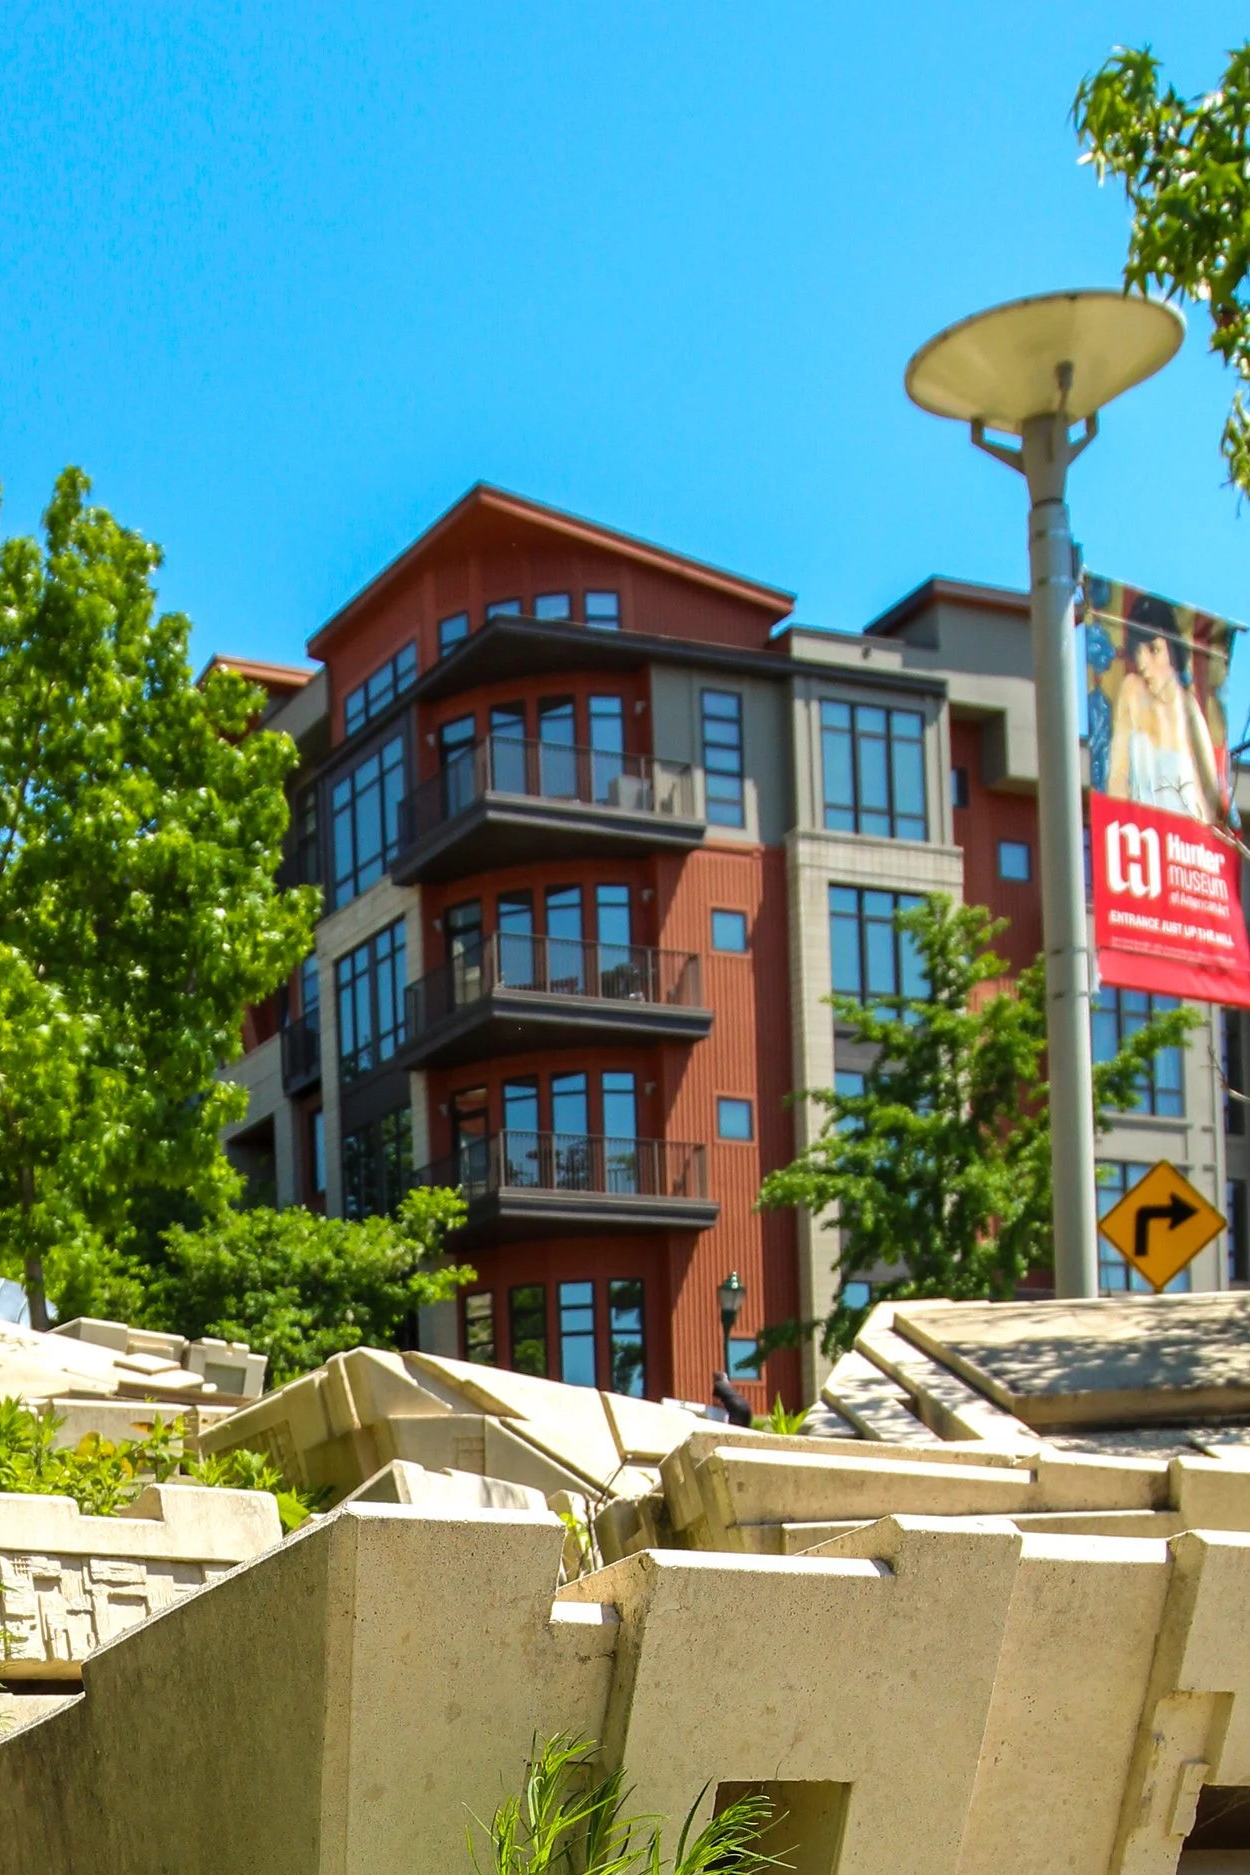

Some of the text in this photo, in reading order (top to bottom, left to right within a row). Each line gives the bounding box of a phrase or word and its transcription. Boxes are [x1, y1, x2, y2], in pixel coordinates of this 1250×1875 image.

[1166, 832, 1225, 874] Hunter
[1109, 909, 1160, 930] ENTRANCE
[1161, 919, 1182, 936] JUST
[1183, 924, 1197, 939] UP
[1197, 926, 1215, 943] THE
